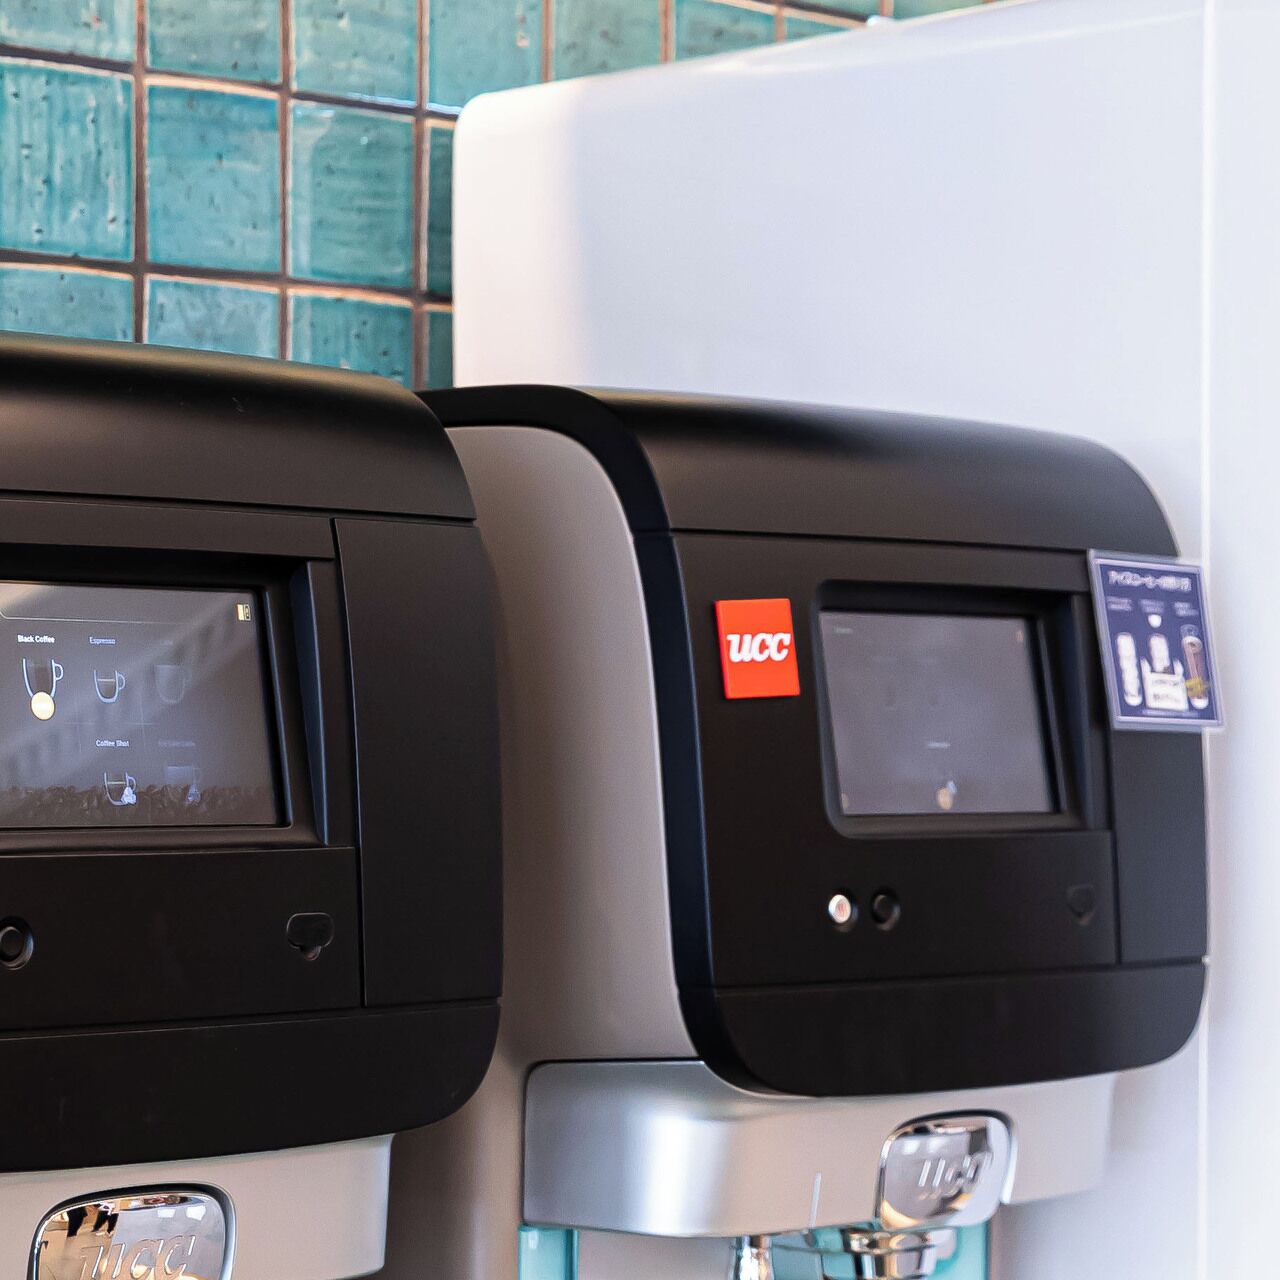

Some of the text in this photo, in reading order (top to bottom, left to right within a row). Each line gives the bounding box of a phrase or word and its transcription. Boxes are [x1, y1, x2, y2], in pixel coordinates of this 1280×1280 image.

[17, 634, 55, 645] Black Coffee
[95, 739, 115, 748] Coffee
